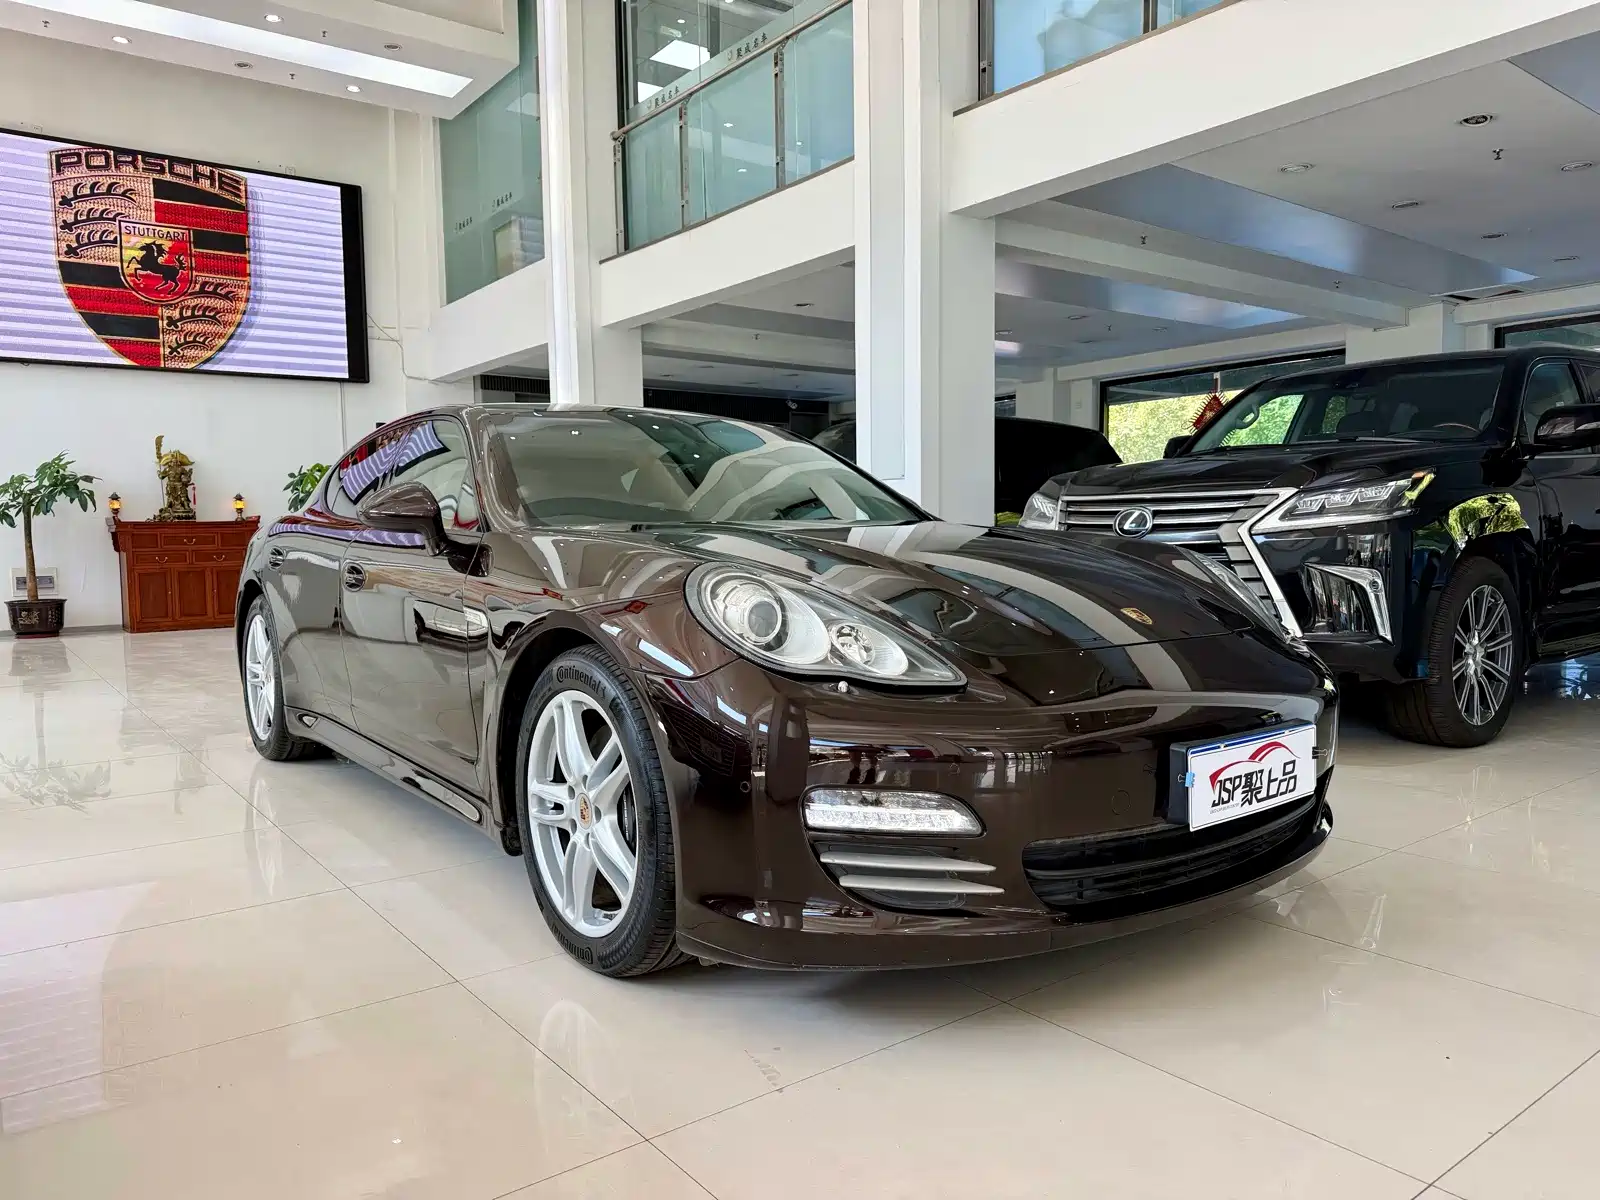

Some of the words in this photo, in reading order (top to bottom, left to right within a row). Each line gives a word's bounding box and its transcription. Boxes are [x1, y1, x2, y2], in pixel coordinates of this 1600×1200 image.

[54, 151, 244, 201] PORSCHE
[124, 225, 187, 242] STUTTGART
[556, 665, 602, 695] Continental
